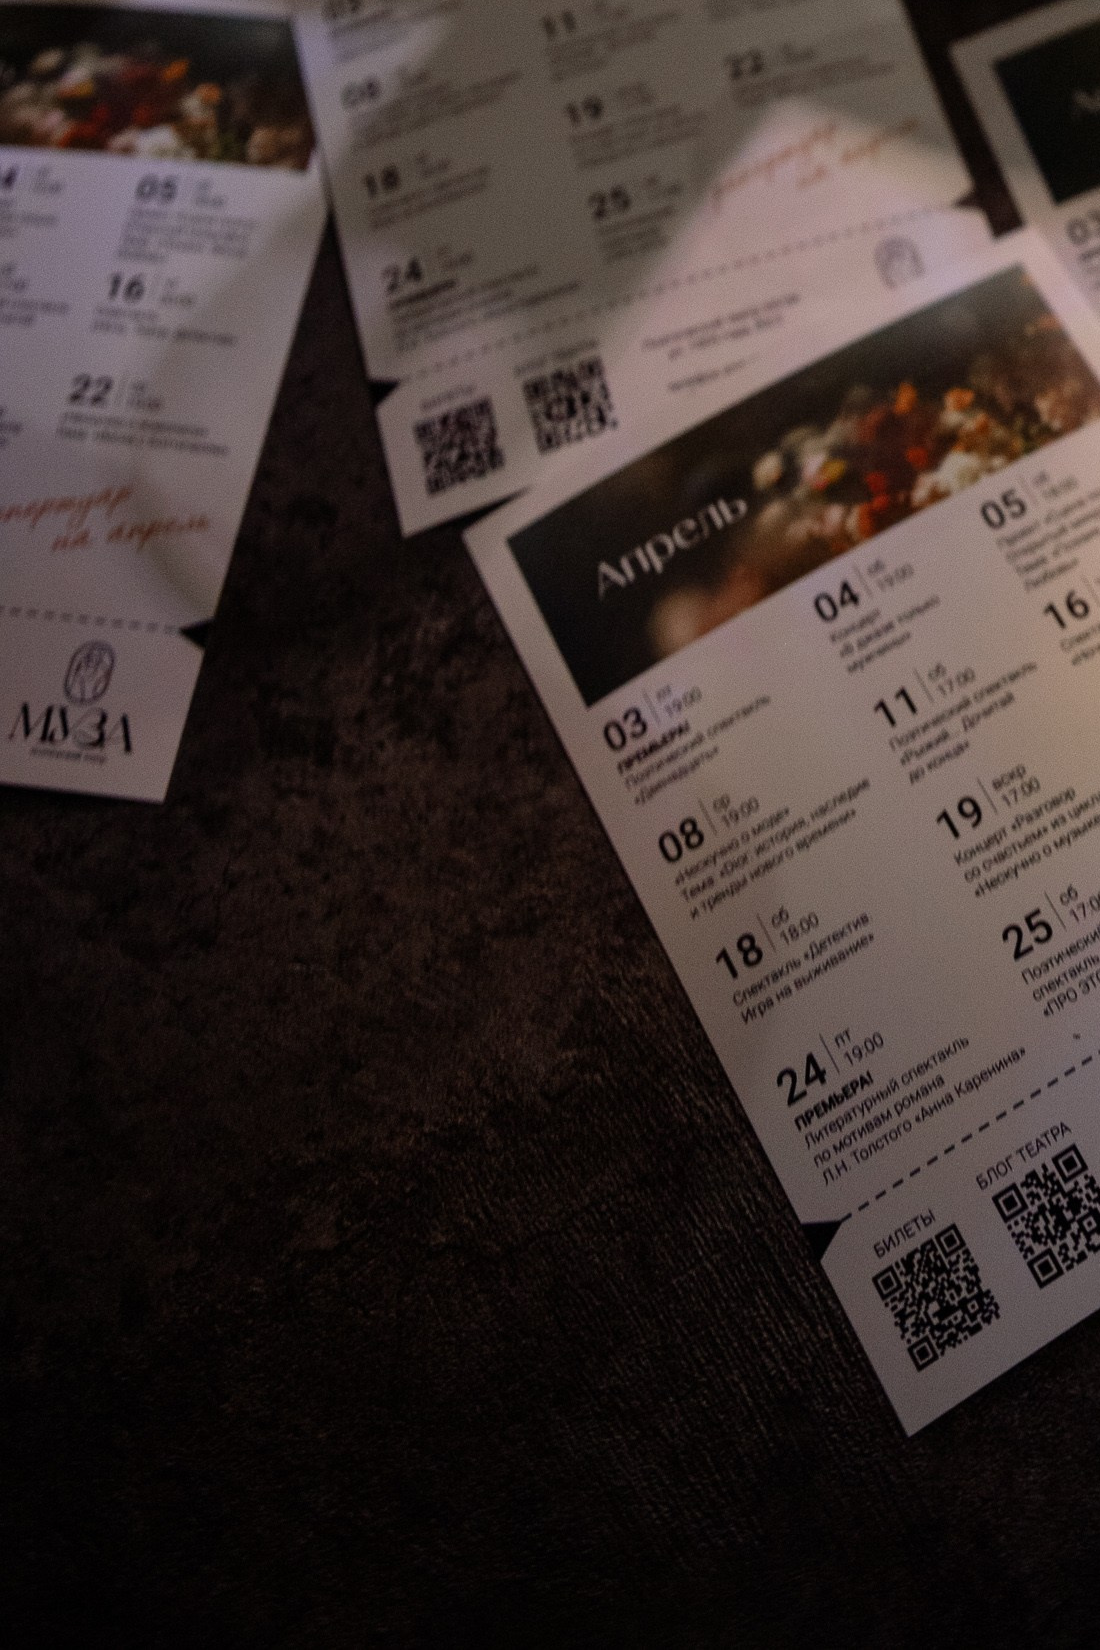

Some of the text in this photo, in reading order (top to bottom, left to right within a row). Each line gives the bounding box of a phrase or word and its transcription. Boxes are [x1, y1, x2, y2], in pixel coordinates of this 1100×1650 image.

[542, 10, 580, 40] 11
[564, 98, 603, 127] 19
[136, 175, 178, 203] 05
[587, 188, 632, 220] 25
[108, 272, 145, 302] 16
[383, 260, 424, 294] 24
[66, 374, 114, 407] 22
[977, 487, 1028, 532] 05
[597, 497, 749, 600] Апрель
[810, 578, 861, 624] 04
[1041, 588, 1091, 631] 16
[8, 702, 133, 755] МУЗА
[600, 705, 649, 753] 03
[871, 685, 919, 729] 11
[990, 763, 1028, 792] вскр
[1000, 775, 1042, 808] 17:00
[720, 795, 761, 829] 19:00
[934, 793, 985, 842] 19
[655, 814, 706, 865] 08
[952, 824, 1008, 867] Концерт
[1041, 843, 1053, 857] о
[768, 904, 791, 929] сб
[1057, 883, 1079, 906] сб
[778, 910, 821, 946] 18:00
[999, 906, 1055, 962] 25
[712, 930, 765, 982] 18
[1030, 953, 1100, 1002] спектакль
[730, 956, 802, 1008] Спектакль
[739, 931, 876, 1026] Игра на выживание»
[1040, 986, 1079, 1018] «ПРО
[832, 1027, 852, 1049] пт
[842, 1030, 885, 1067] 19:00
[773, 1050, 829, 1108] 24
[792, 1069, 875, 1132] ПРЕМЬЕРА!
[802, 1035, 970, 1151] Литературный спектакль
[812, 1073, 946, 1168] по мотивам романа
[849, 1117, 913, 1165] Толстого
[912, 1091, 955, 1124] «Анна
[953, 1045, 1027, 1099] Каренина»
[974, 1120, 1072, 1191] БЛОГ ТЕАТРА
[871, 1208, 936, 1259] БИЛЕТЫ
